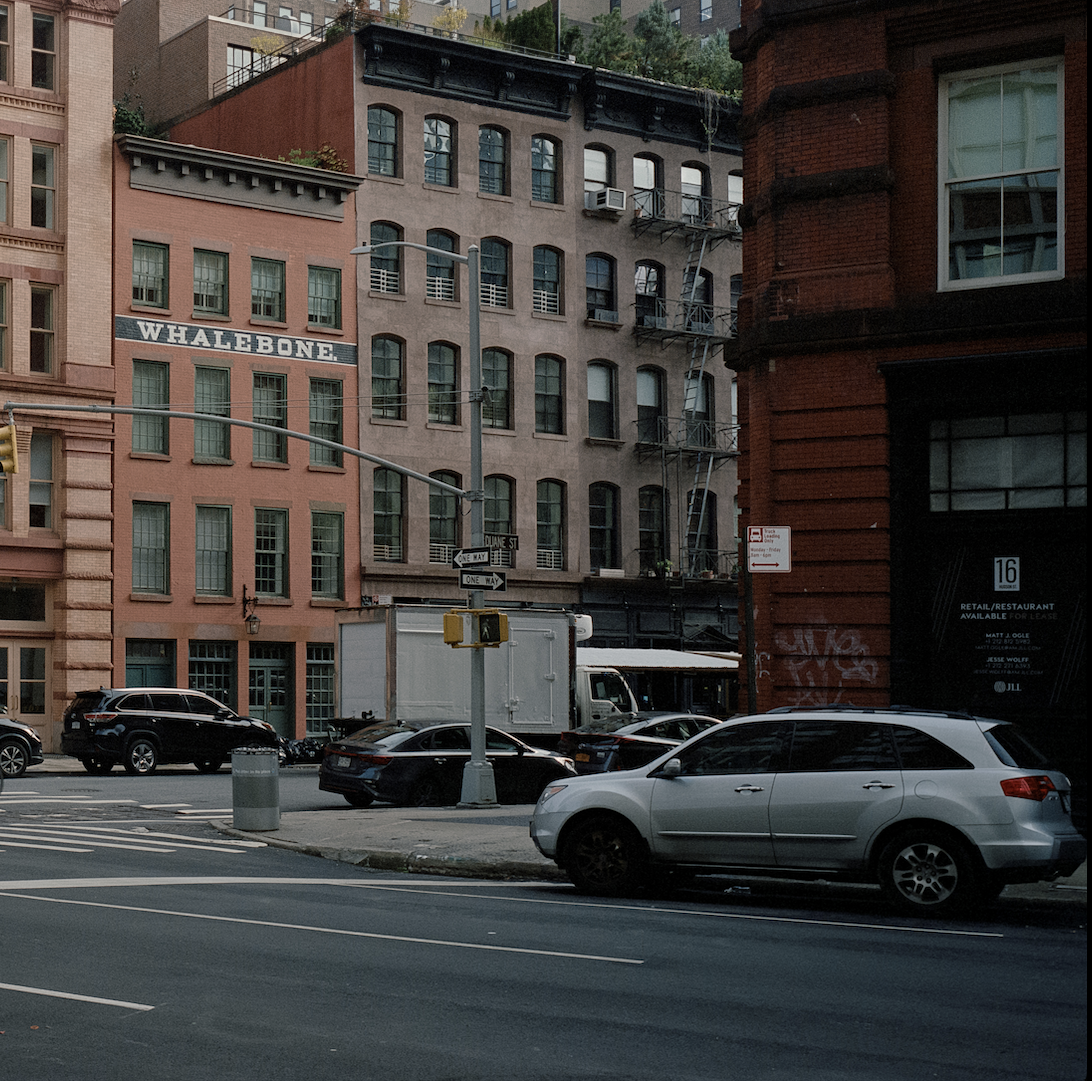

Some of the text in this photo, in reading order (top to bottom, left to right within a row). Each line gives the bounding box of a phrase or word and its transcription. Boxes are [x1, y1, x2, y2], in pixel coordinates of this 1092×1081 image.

[484, 535, 517, 549] DUANE ST
[996, 559, 1016, 583] 16
[466, 576, 499, 585] ONE WAY
[960, 603, 1054, 611] RETAIL/RESTAURANT
[1006, 683, 1022, 691] JLL
